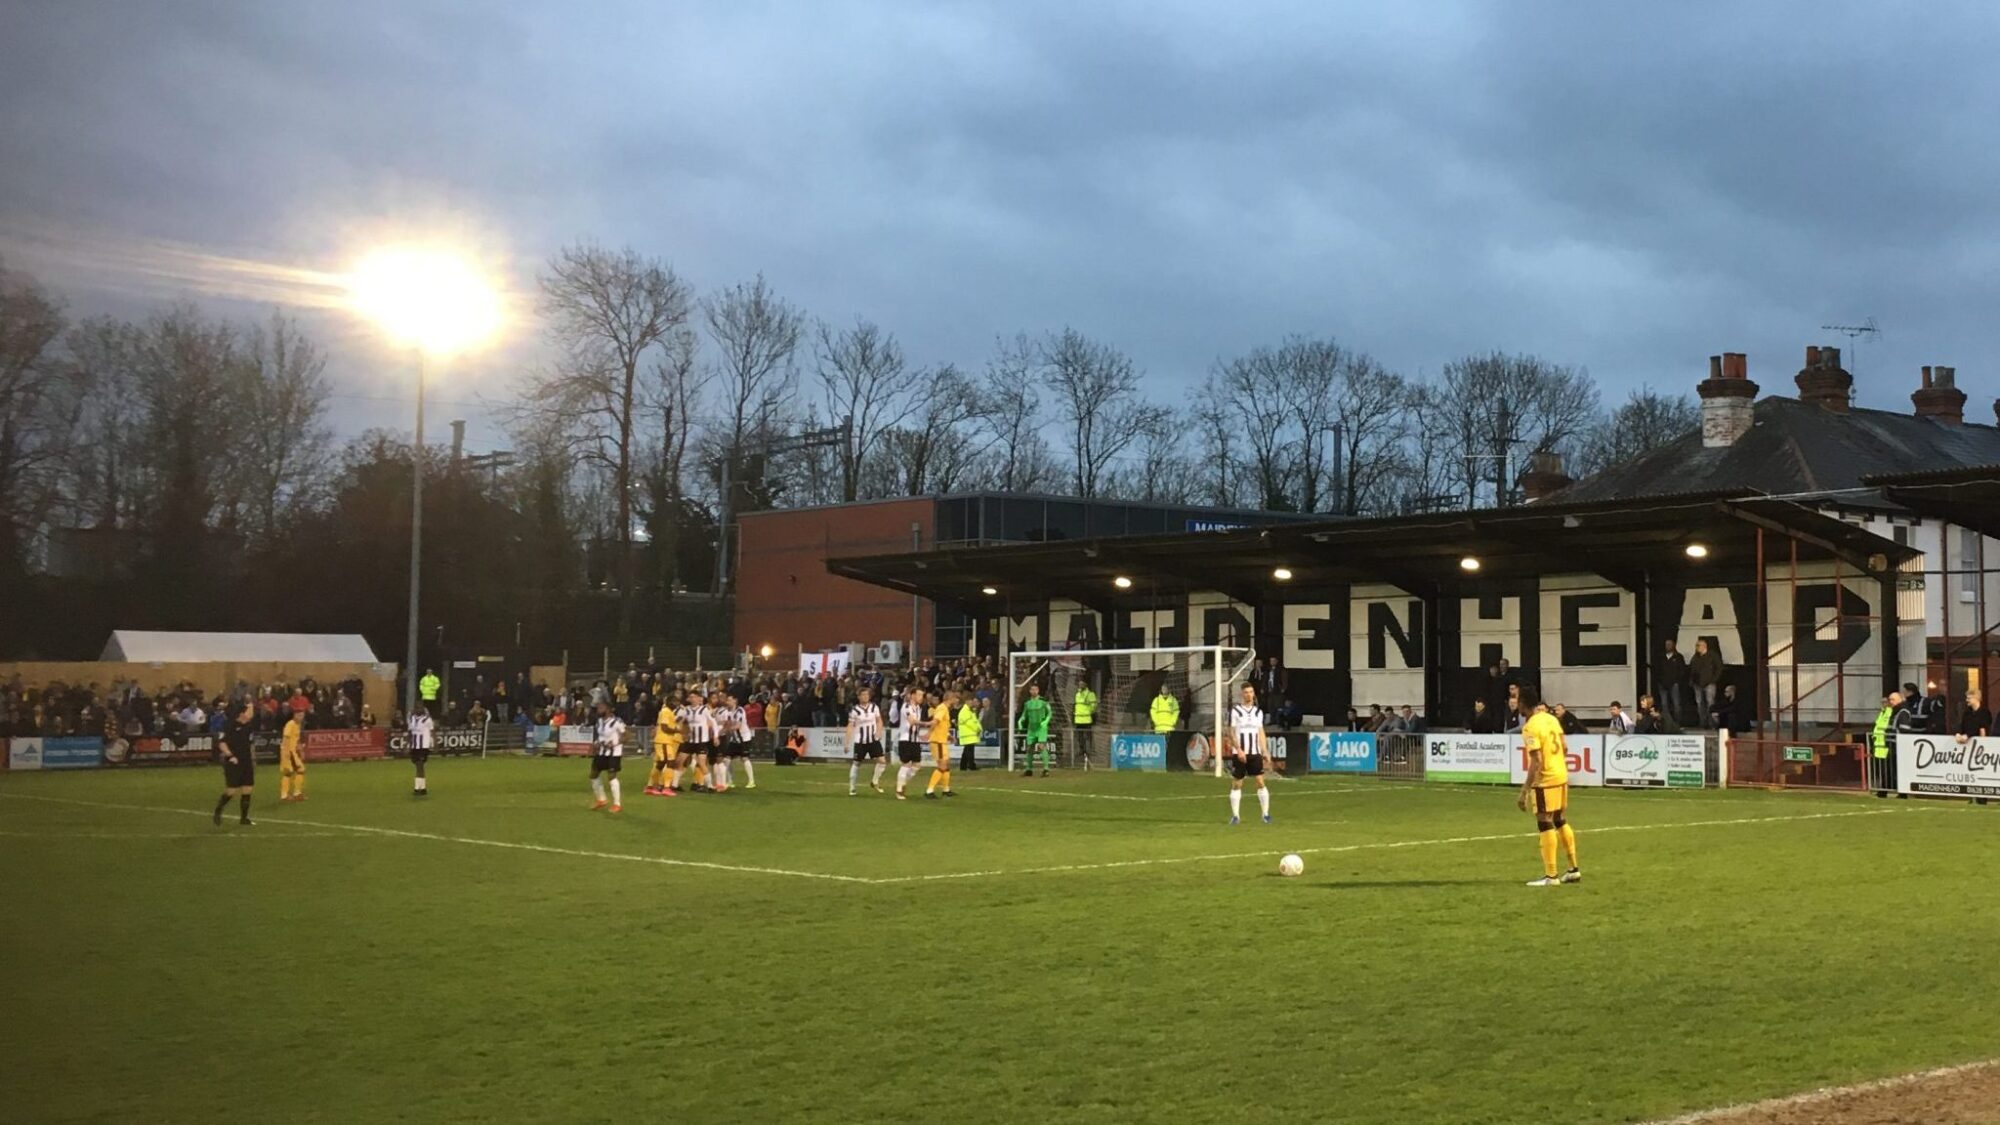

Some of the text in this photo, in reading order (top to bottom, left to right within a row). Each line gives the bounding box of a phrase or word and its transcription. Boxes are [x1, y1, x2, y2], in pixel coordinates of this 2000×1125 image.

[390, 735, 482, 749] CHPIONS!
[1131, 742, 1160, 758] JAKO
[1335, 741, 1370, 758] JAKO
[1516, 747, 1596, 773] Tal
[1914, 738, 2000, 772] David Lloy
[1946, 773, 1975, 783] CLUBS
[1918, 784, 1960, 792] MAIDENHEAD
